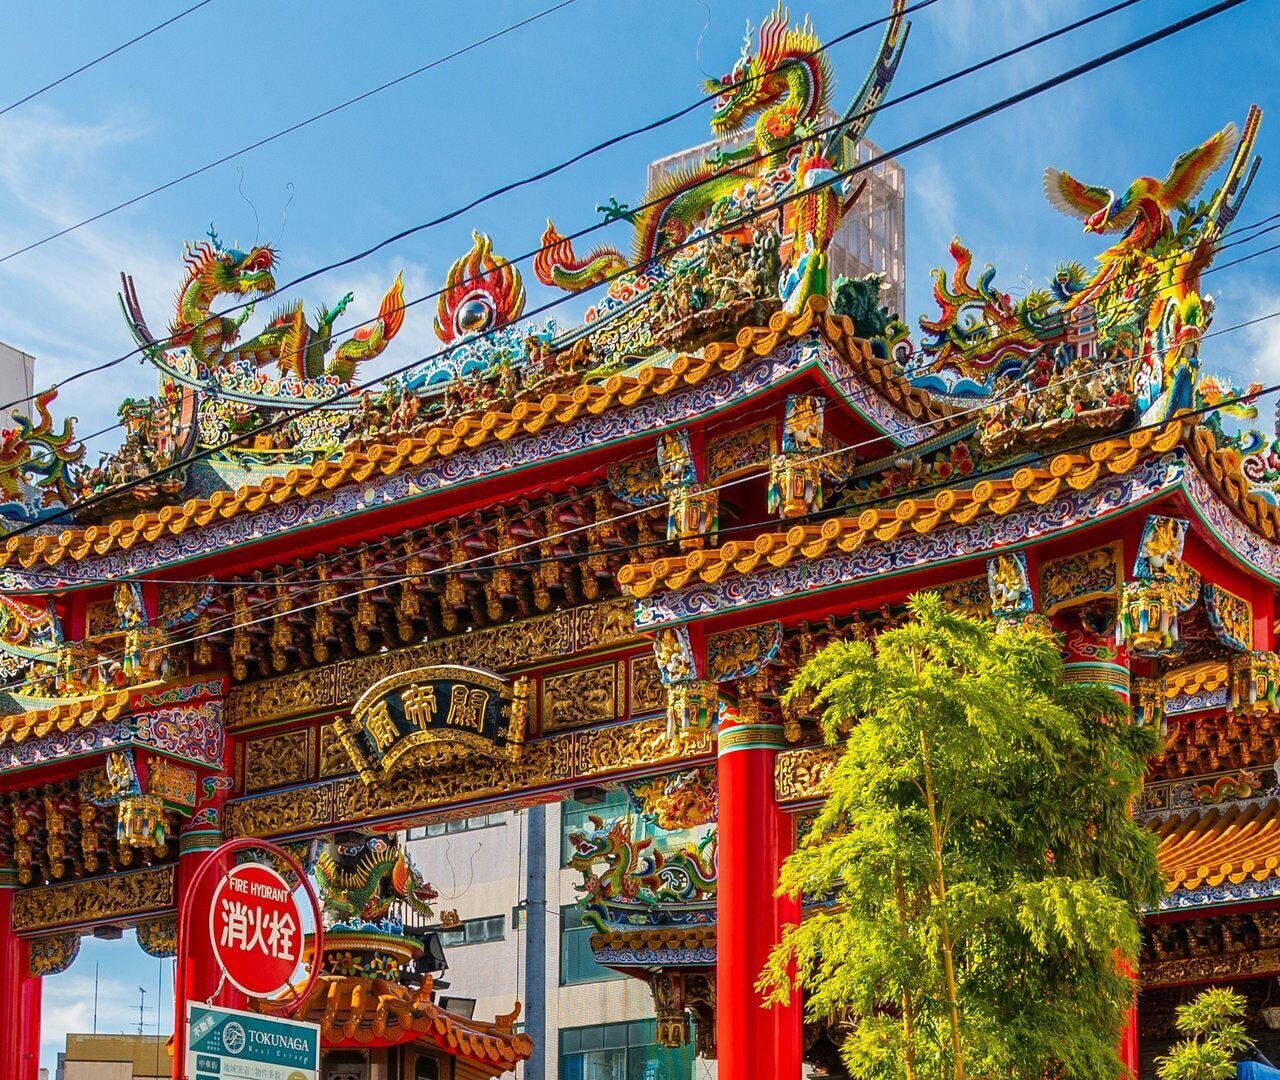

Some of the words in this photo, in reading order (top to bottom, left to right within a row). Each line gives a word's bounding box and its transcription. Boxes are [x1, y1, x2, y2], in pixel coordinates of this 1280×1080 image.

[229, 877, 249, 894] FIRE
[250, 881, 288, 904] HYDRANT
[220, 898, 296, 961] 消火栓
[192, 1015, 216, 1037] 不動産
[248, 1029, 310, 1052] TOKUNAGA
